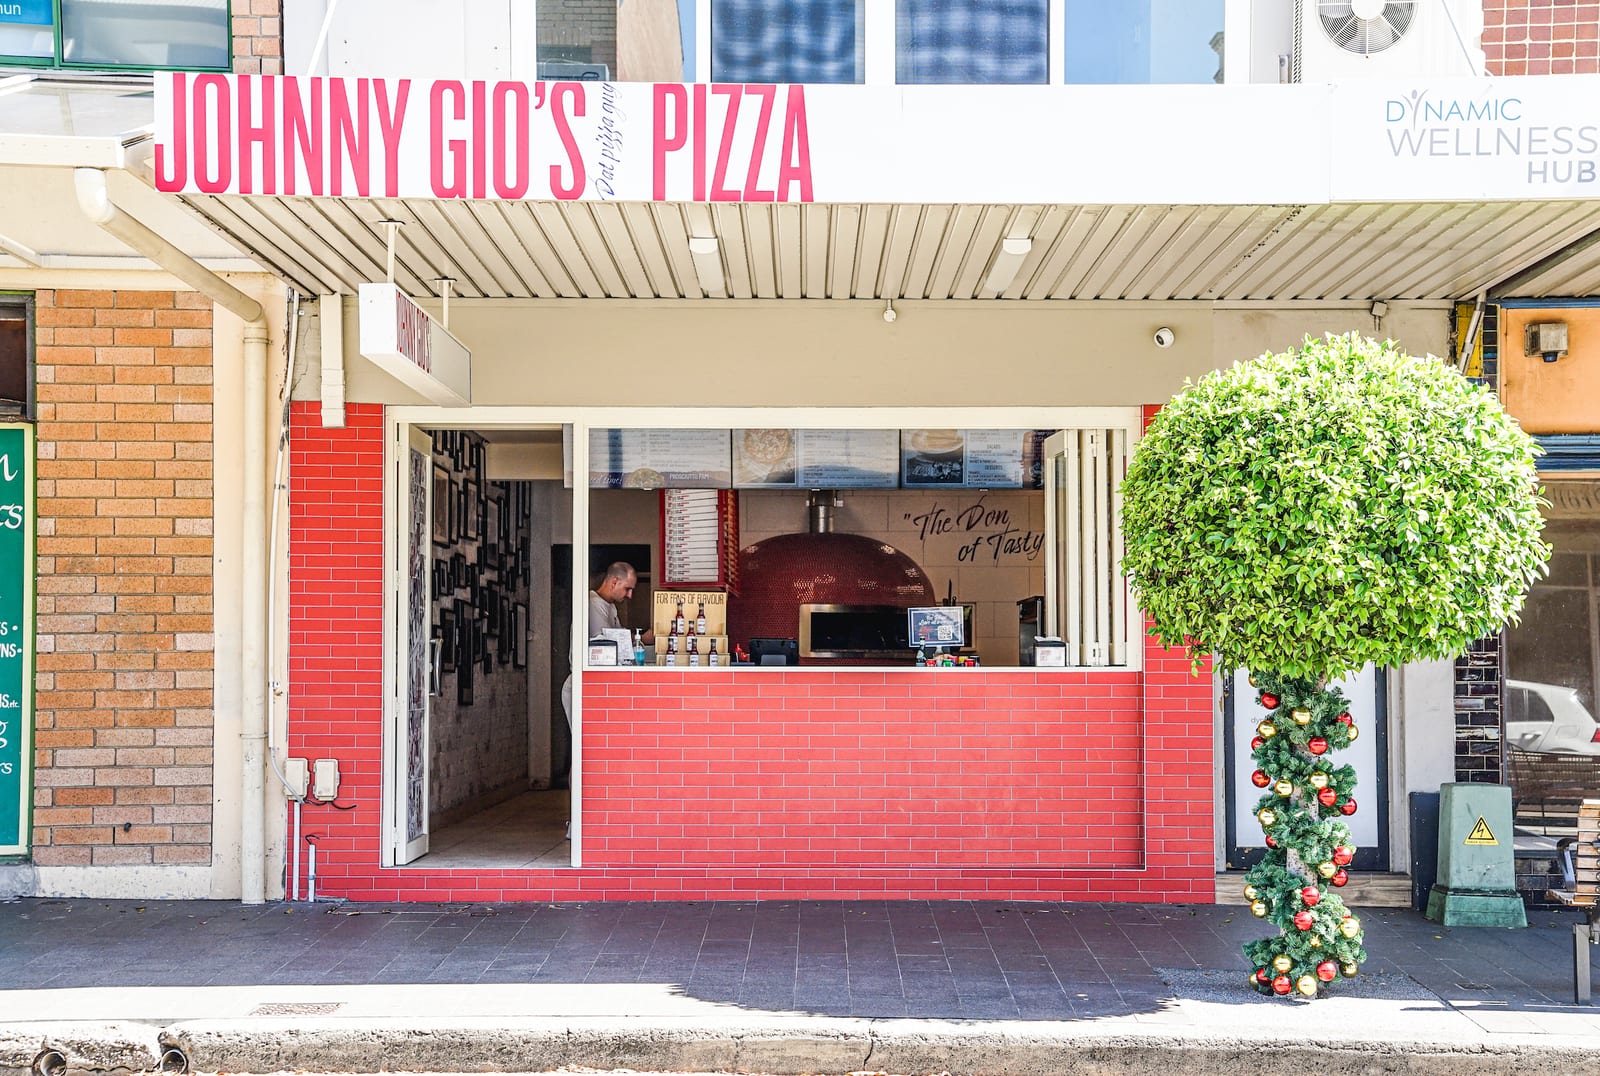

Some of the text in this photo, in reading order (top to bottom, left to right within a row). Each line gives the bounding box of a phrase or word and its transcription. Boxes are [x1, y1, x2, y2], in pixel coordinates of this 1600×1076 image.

[602, 82, 625, 118] guy
[1386, 90, 1522, 129] DYNAMIC
[155, 72, 587, 200] JOHNNY GIO'S
[595, 116, 623, 163] pizza
[652, 83, 814, 202] PIZZA
[1386, 126, 1599, 156] WELLNESS
[1528, 160, 1597, 184] HUB
[956, 495, 1010, 531] Don
[958, 523, 1045, 567] of Tasty
[656, 592, 669, 604] FOR
[687, 593, 696, 604] OF
